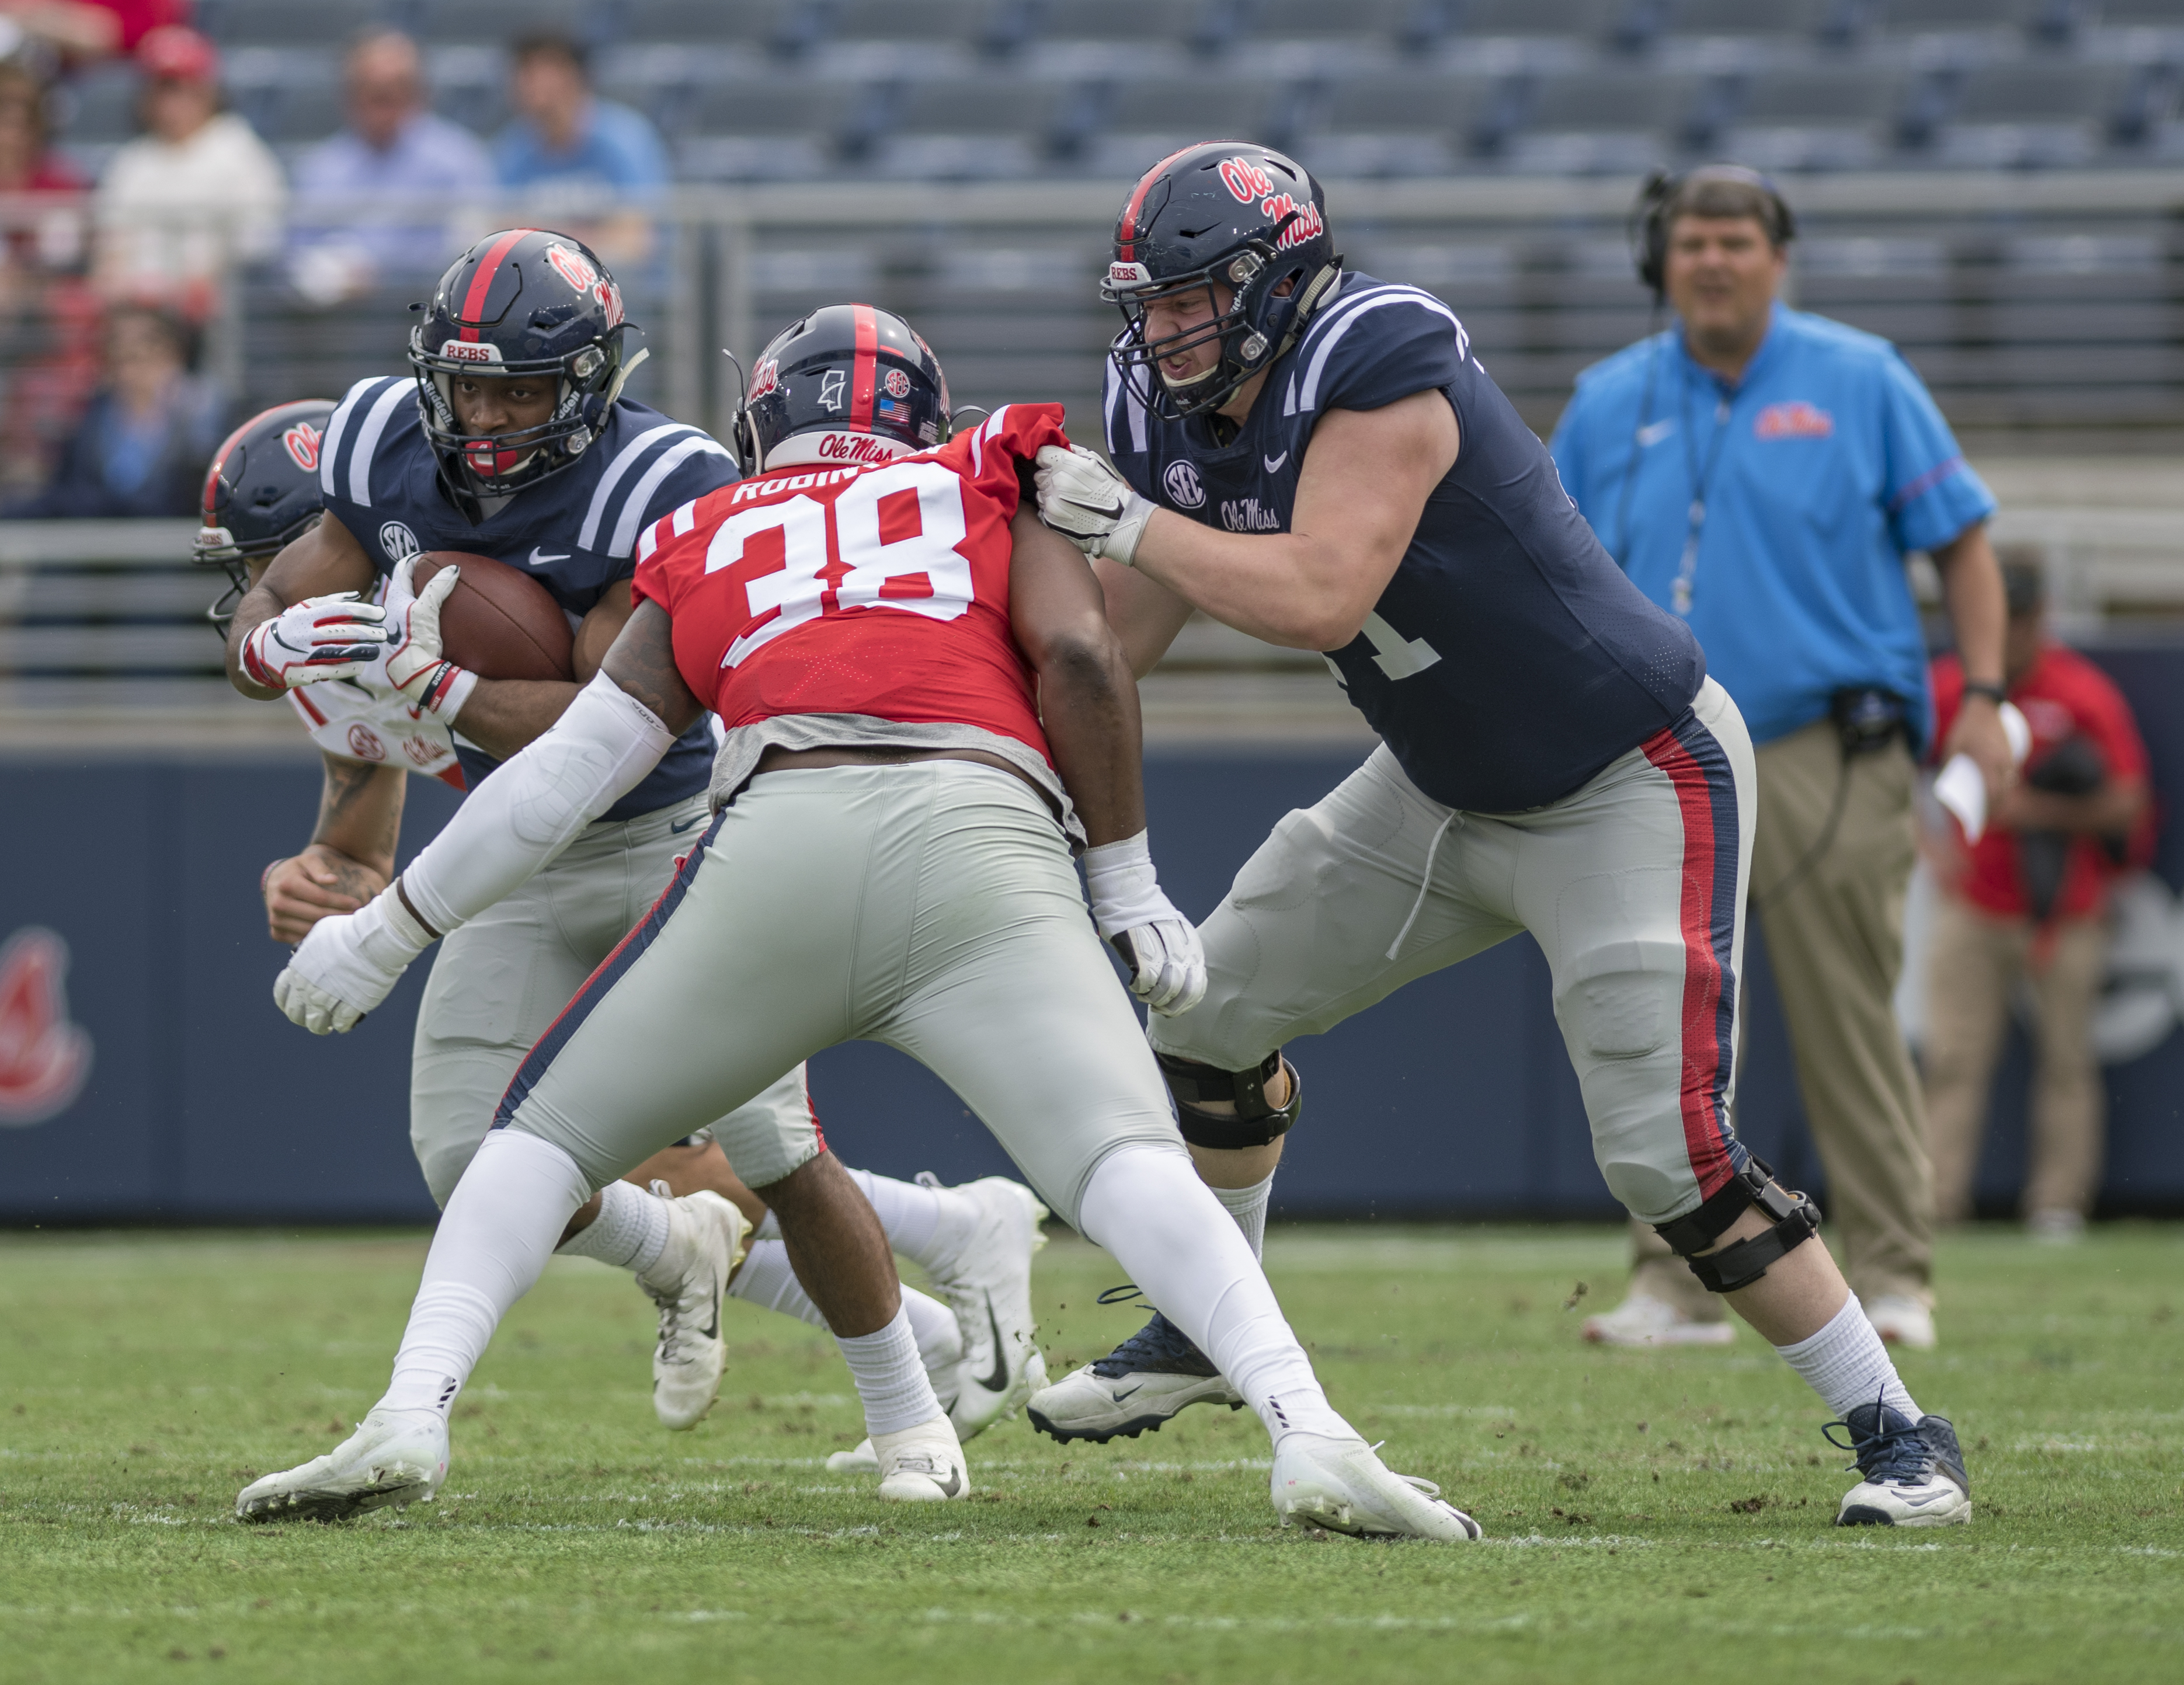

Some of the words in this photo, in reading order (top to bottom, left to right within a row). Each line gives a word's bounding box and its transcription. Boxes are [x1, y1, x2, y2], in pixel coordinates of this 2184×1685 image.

[1218, 157, 1274, 204] Ole
[1261, 192, 1323, 251] Miss
[545, 243, 597, 293] Ole
[1111, 266, 1138, 281] REBS
[446, 344, 490, 361] REBS
[887, 371, 909, 396] SEC
[283, 422, 323, 472] Ol
[819, 434, 849, 458] Ole
[848, 436, 893, 462] Miss
[1168, 464, 1204, 506] SEC
[1221, 500, 1247, 531] Ole
[1240, 498, 1280, 530] Miss
[704, 462, 974, 669] 38
